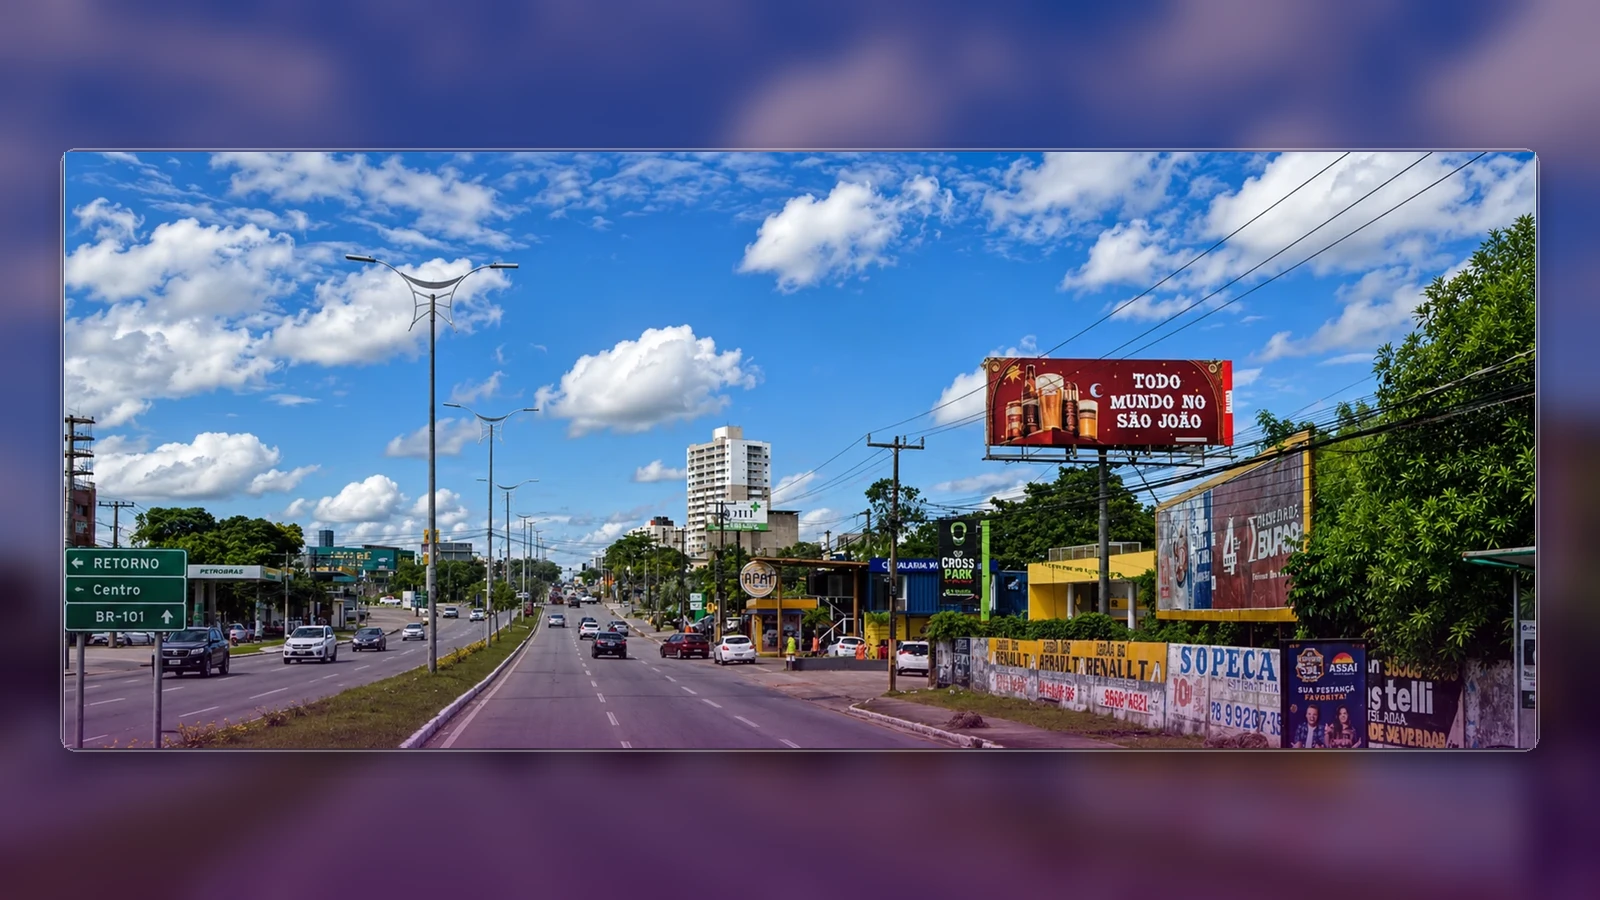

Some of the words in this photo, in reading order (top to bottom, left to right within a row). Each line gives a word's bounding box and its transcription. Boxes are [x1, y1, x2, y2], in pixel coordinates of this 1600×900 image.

[1132, 373, 1181, 389] TODO
[1110, 394, 1174, 409] MUNDO
[1181, 394, 1206, 409] NO
[93, 557, 160, 570] RETORNO
[941, 557, 975, 569] CROSS
[944, 569, 972, 580] PARK
[92, 584, 141, 596] Centro
[95, 611, 145, 623] BR-101
[1180, 646, 1277, 682] SOPECA
